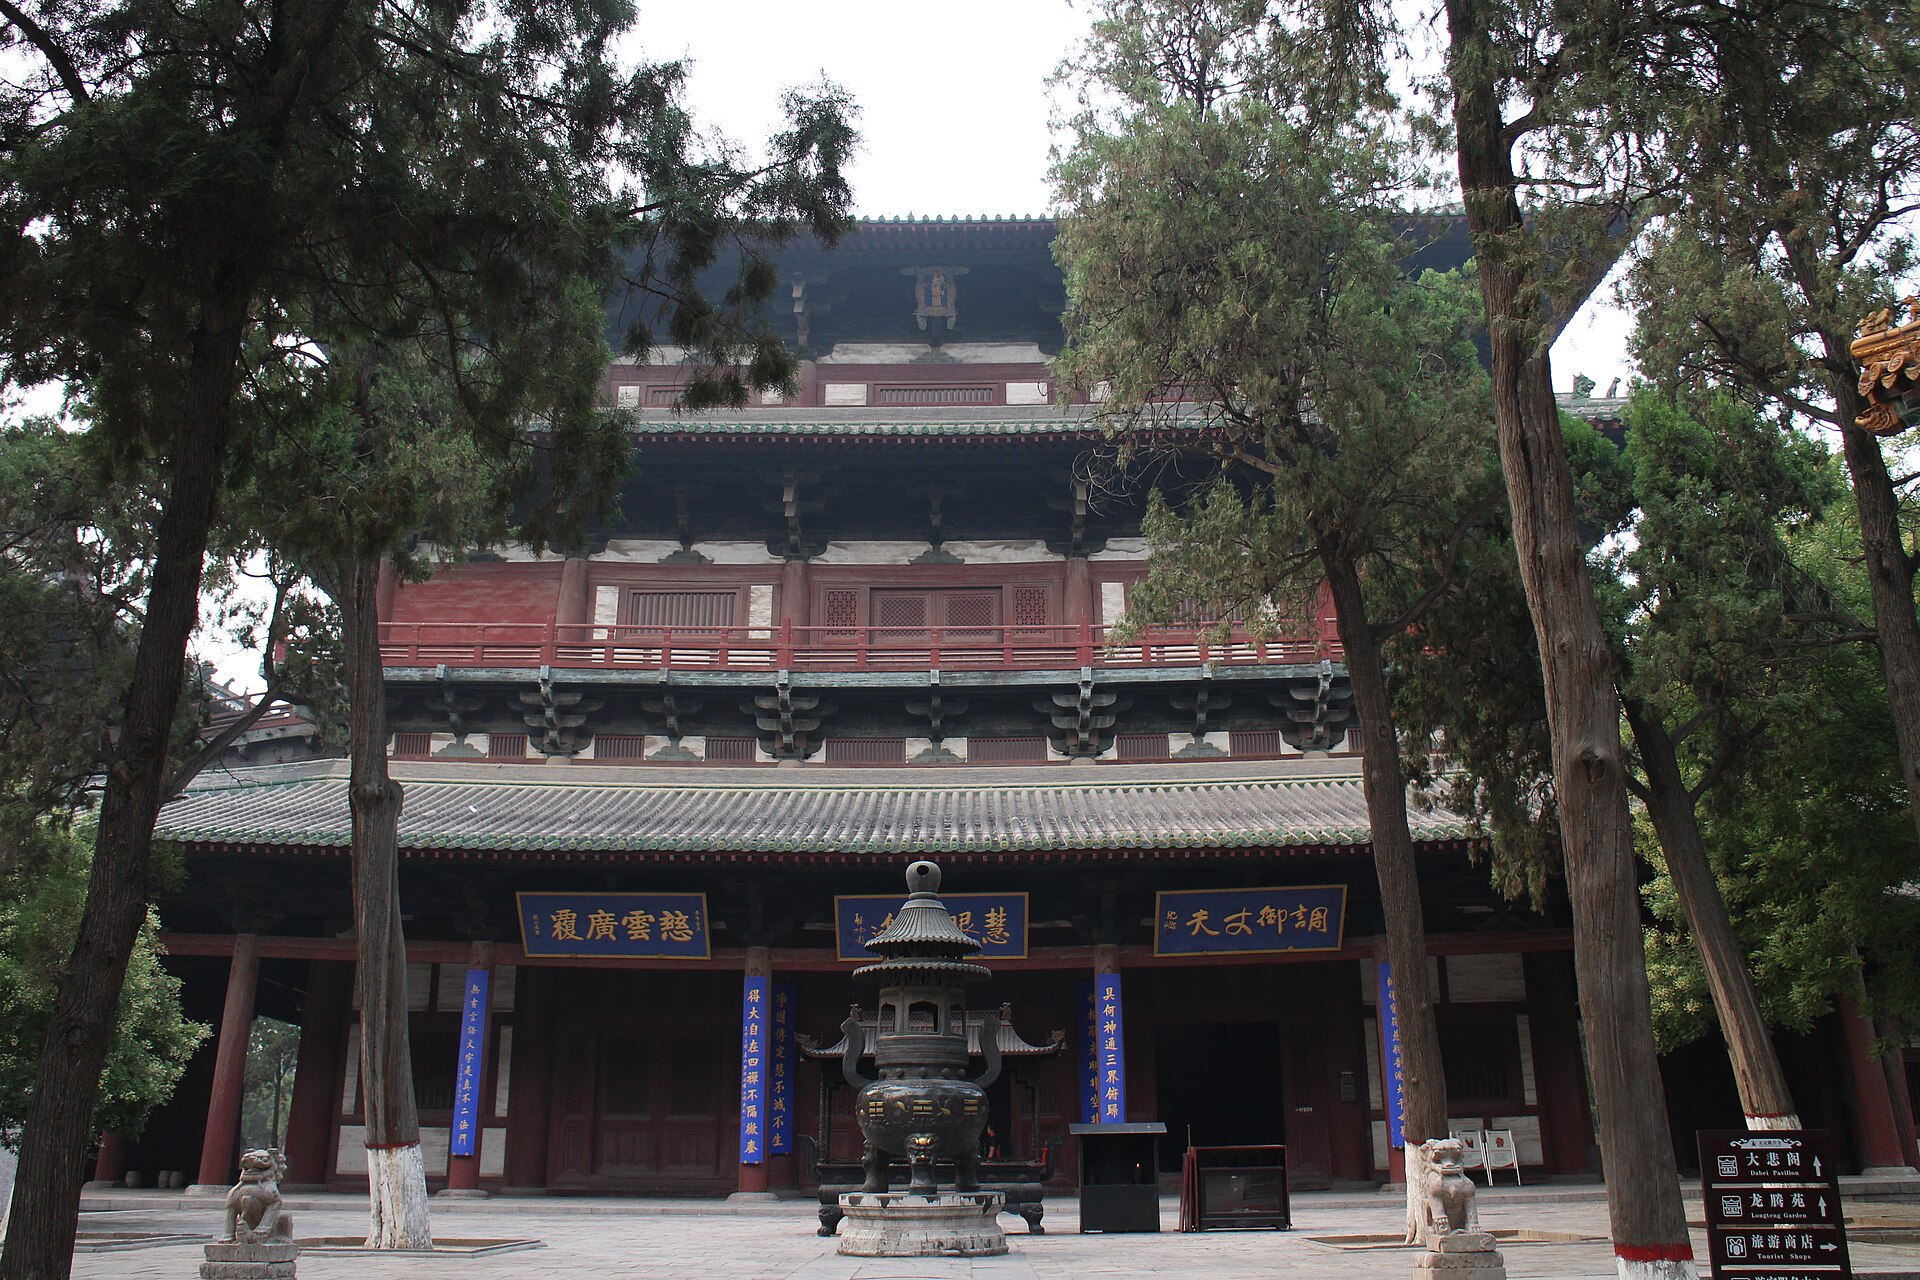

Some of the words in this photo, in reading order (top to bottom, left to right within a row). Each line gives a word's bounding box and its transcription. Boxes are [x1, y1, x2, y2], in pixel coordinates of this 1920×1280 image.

[1745, 1152, 1801, 1167] 大悲阁
[1749, 1193, 1806, 1208] 龙腾苑
[1750, 1234, 1813, 1249] 旅游商店
[1789, 1253, 1811, 1261] Shops
